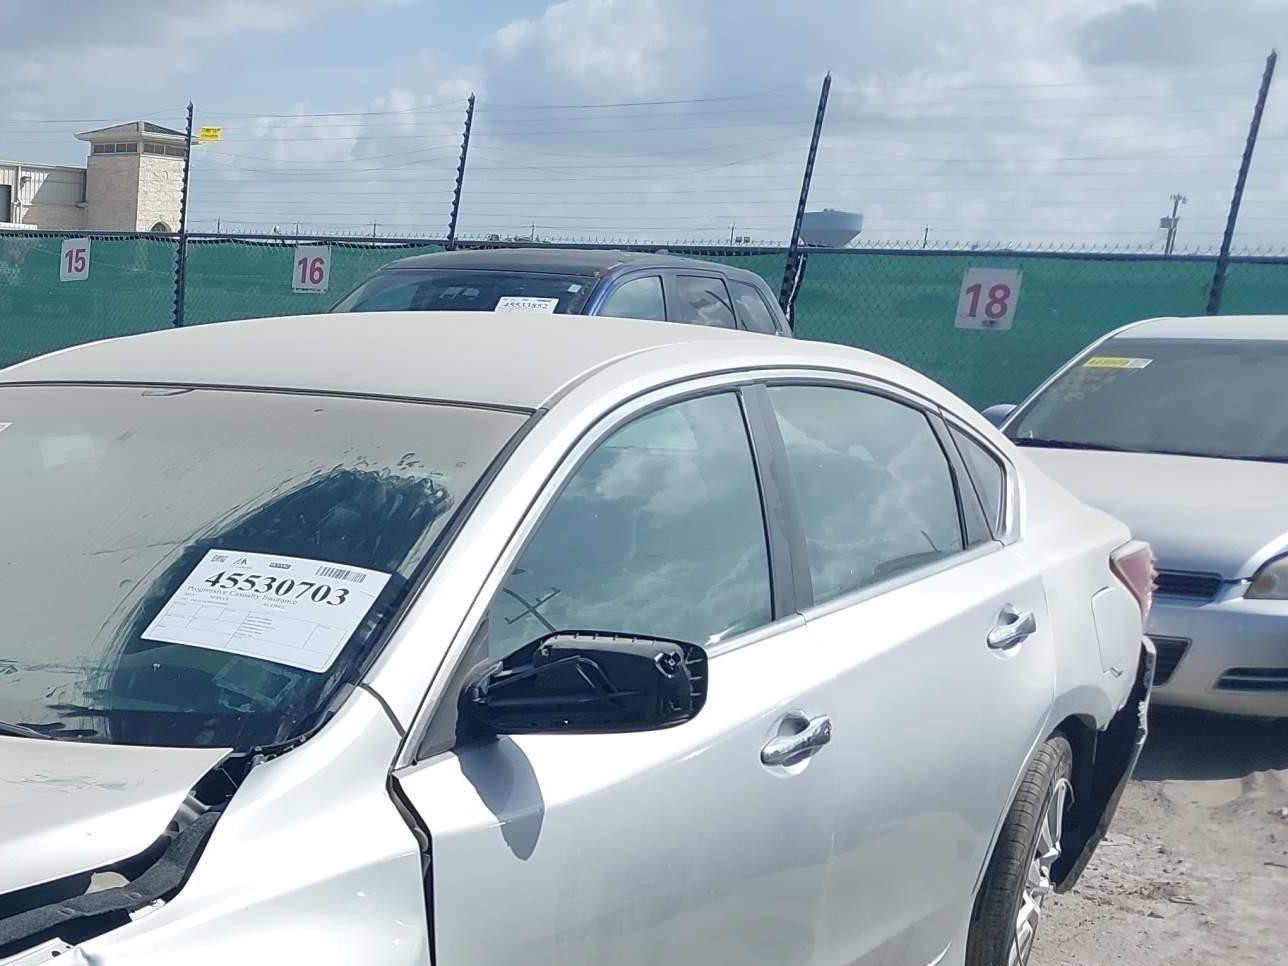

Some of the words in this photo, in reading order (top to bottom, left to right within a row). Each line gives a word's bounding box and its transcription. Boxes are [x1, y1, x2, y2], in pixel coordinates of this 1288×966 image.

[65, 249, 87, 273] 15
[298, 257, 324, 284] 16
[966, 284, 1011, 319] 18
[205, 571, 350, 606] 45530703
